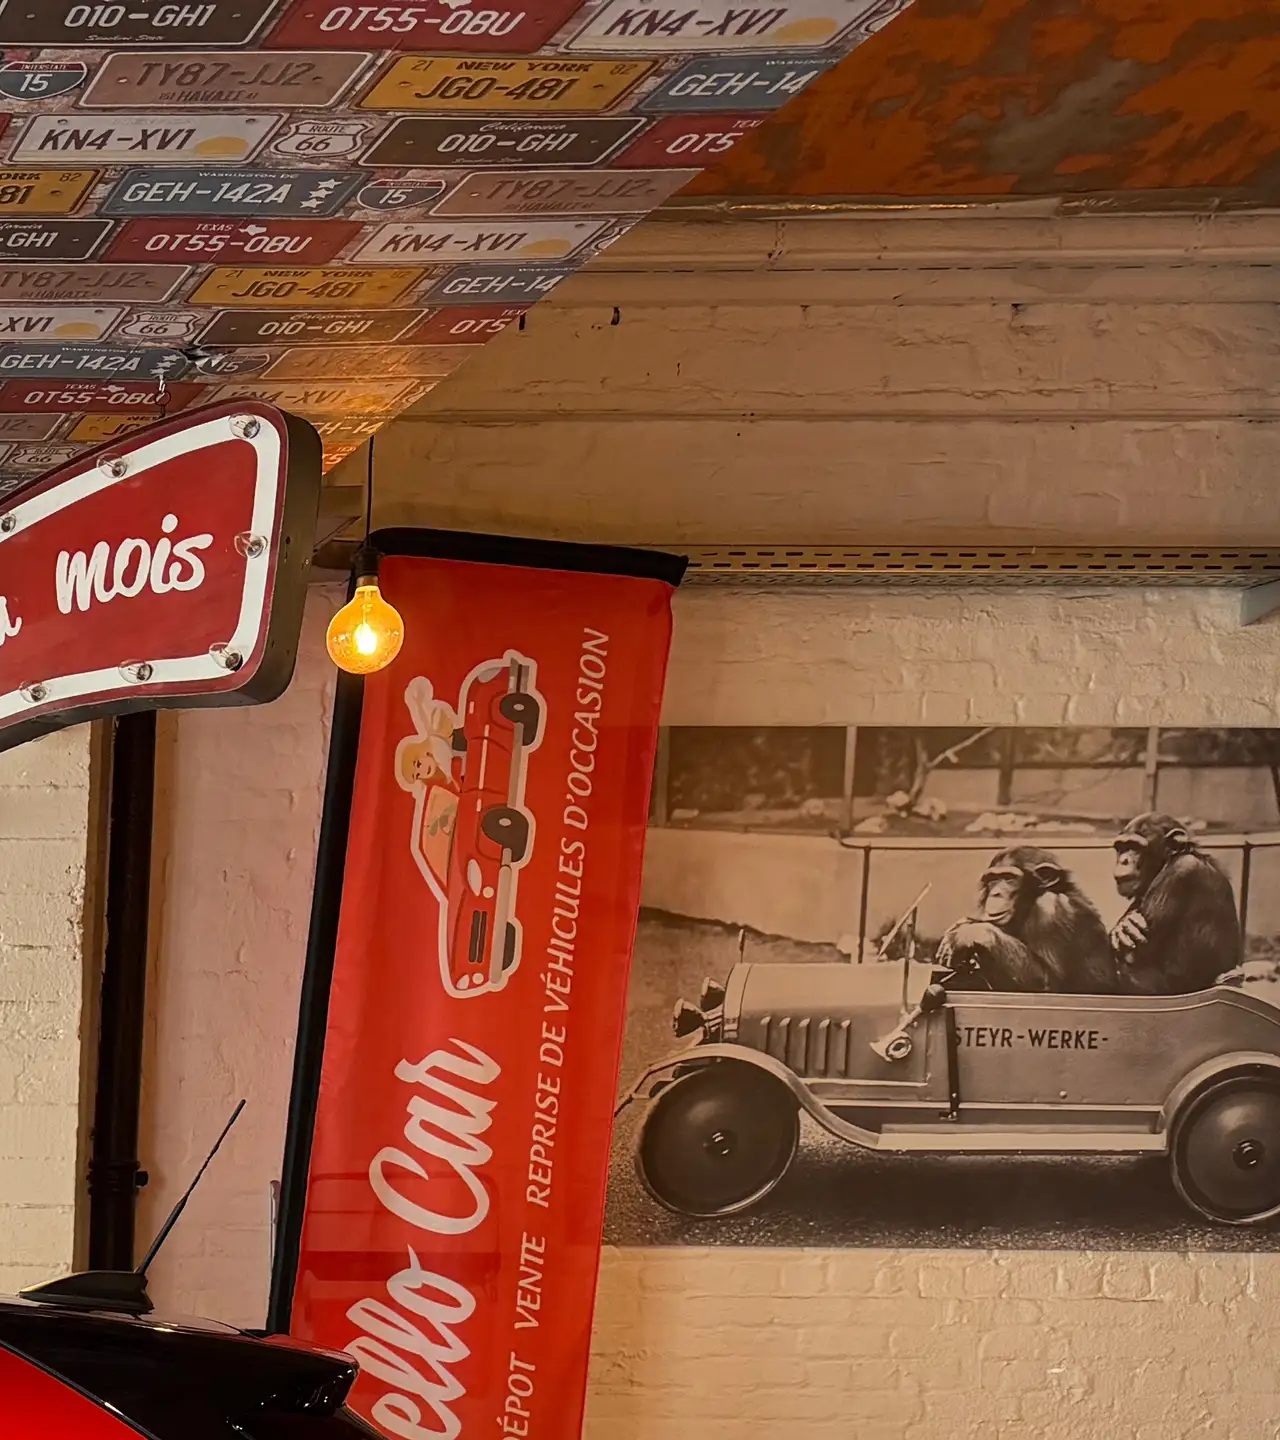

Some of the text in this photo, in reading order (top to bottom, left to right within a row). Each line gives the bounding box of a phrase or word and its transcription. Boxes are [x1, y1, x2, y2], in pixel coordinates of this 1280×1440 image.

[20, 73, 57, 93] 15
[411, 60, 430, 72] 21
[456, 60, 517, 72] NEW
[525, 61, 594, 73] YORK
[412, 77, 578, 101] JGO-481
[668, 71, 812, 97] GEH-14
[295, 136, 332, 151] 66
[121, 181, 288, 205] GEH-142A
[56, 513, 214, 614] mois
[562, 626, 611, 834] D'OCCASION
[540, 837, 587, 1013] VÉHICULES
[539, 1020, 567, 1067] DE
[369, 1037, 502, 1235] Car
[526, 1071, 563, 1208] REPRISE
[514, 1231, 547, 1331] VENTE
